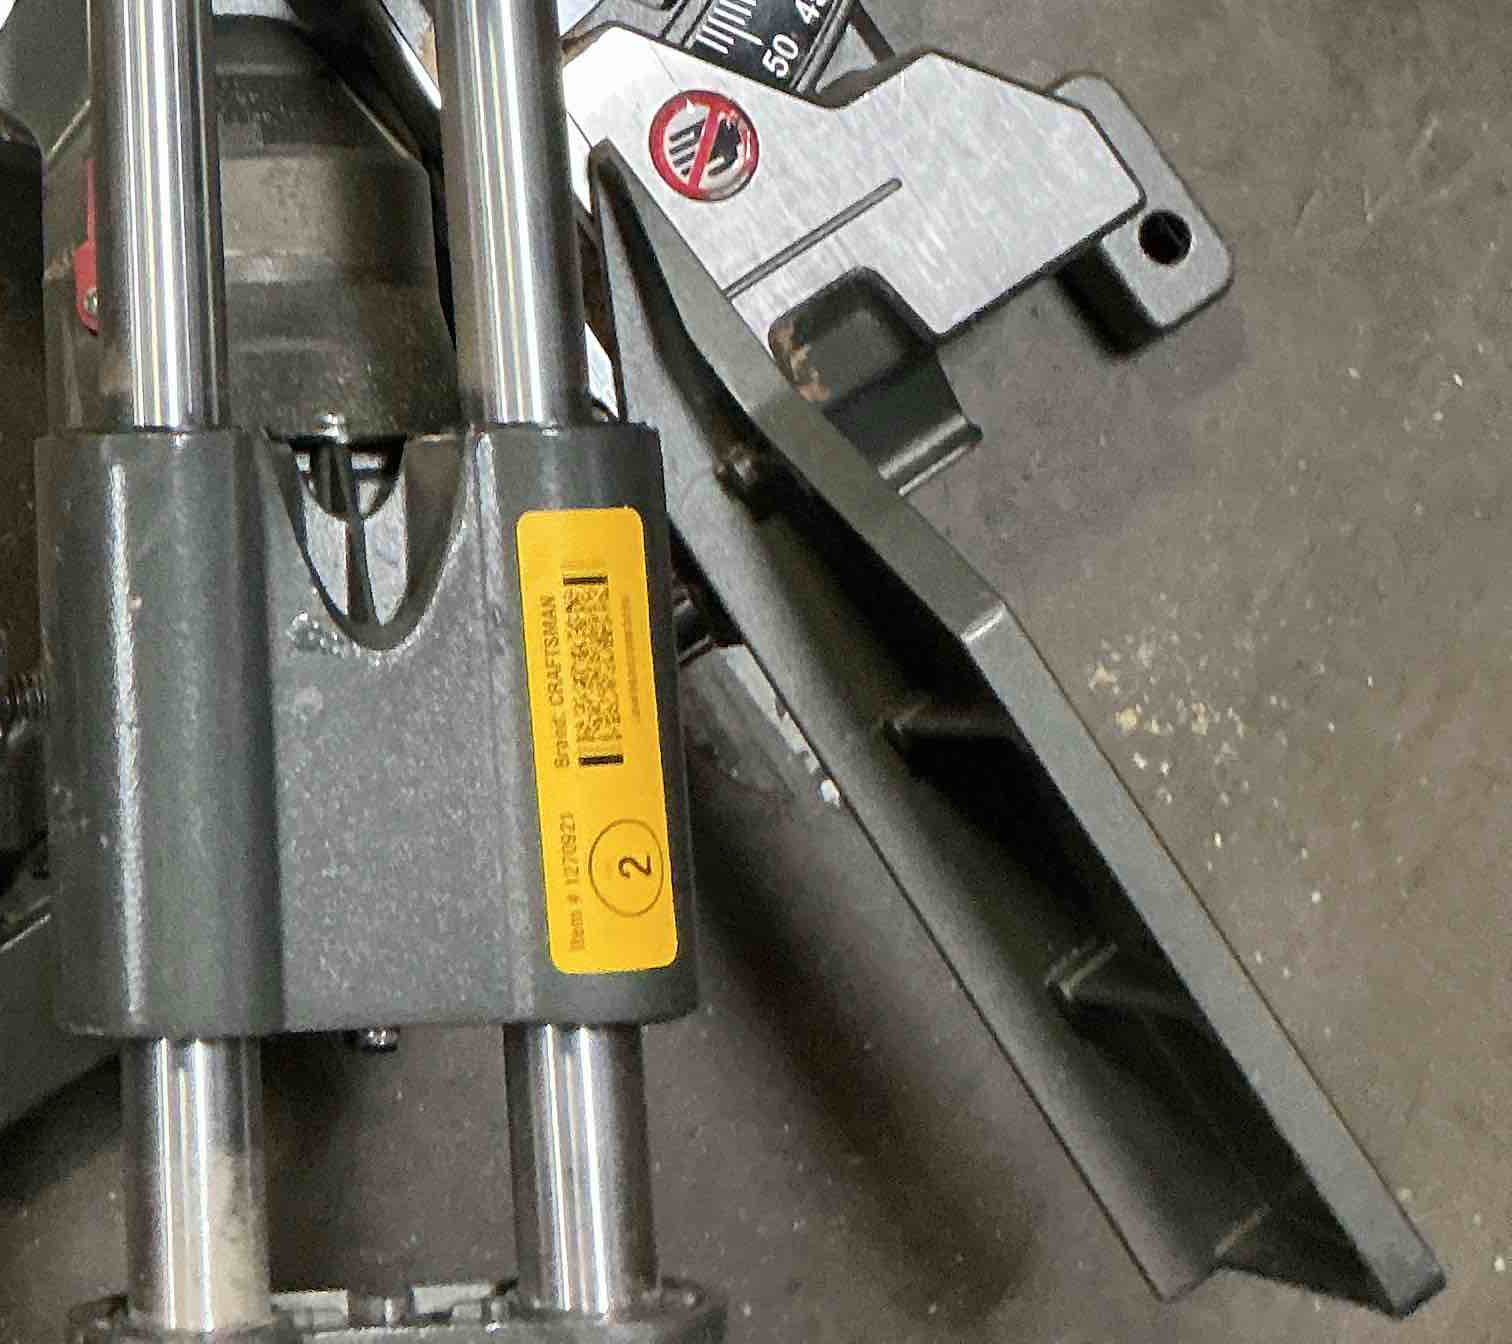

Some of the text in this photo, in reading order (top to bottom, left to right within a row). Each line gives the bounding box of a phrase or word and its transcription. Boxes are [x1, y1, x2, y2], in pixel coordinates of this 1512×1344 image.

[761, 33, 799, 79] 50
[540, 595, 565, 705] CRAFTSMAN
[618, 855, 652, 879] 2
